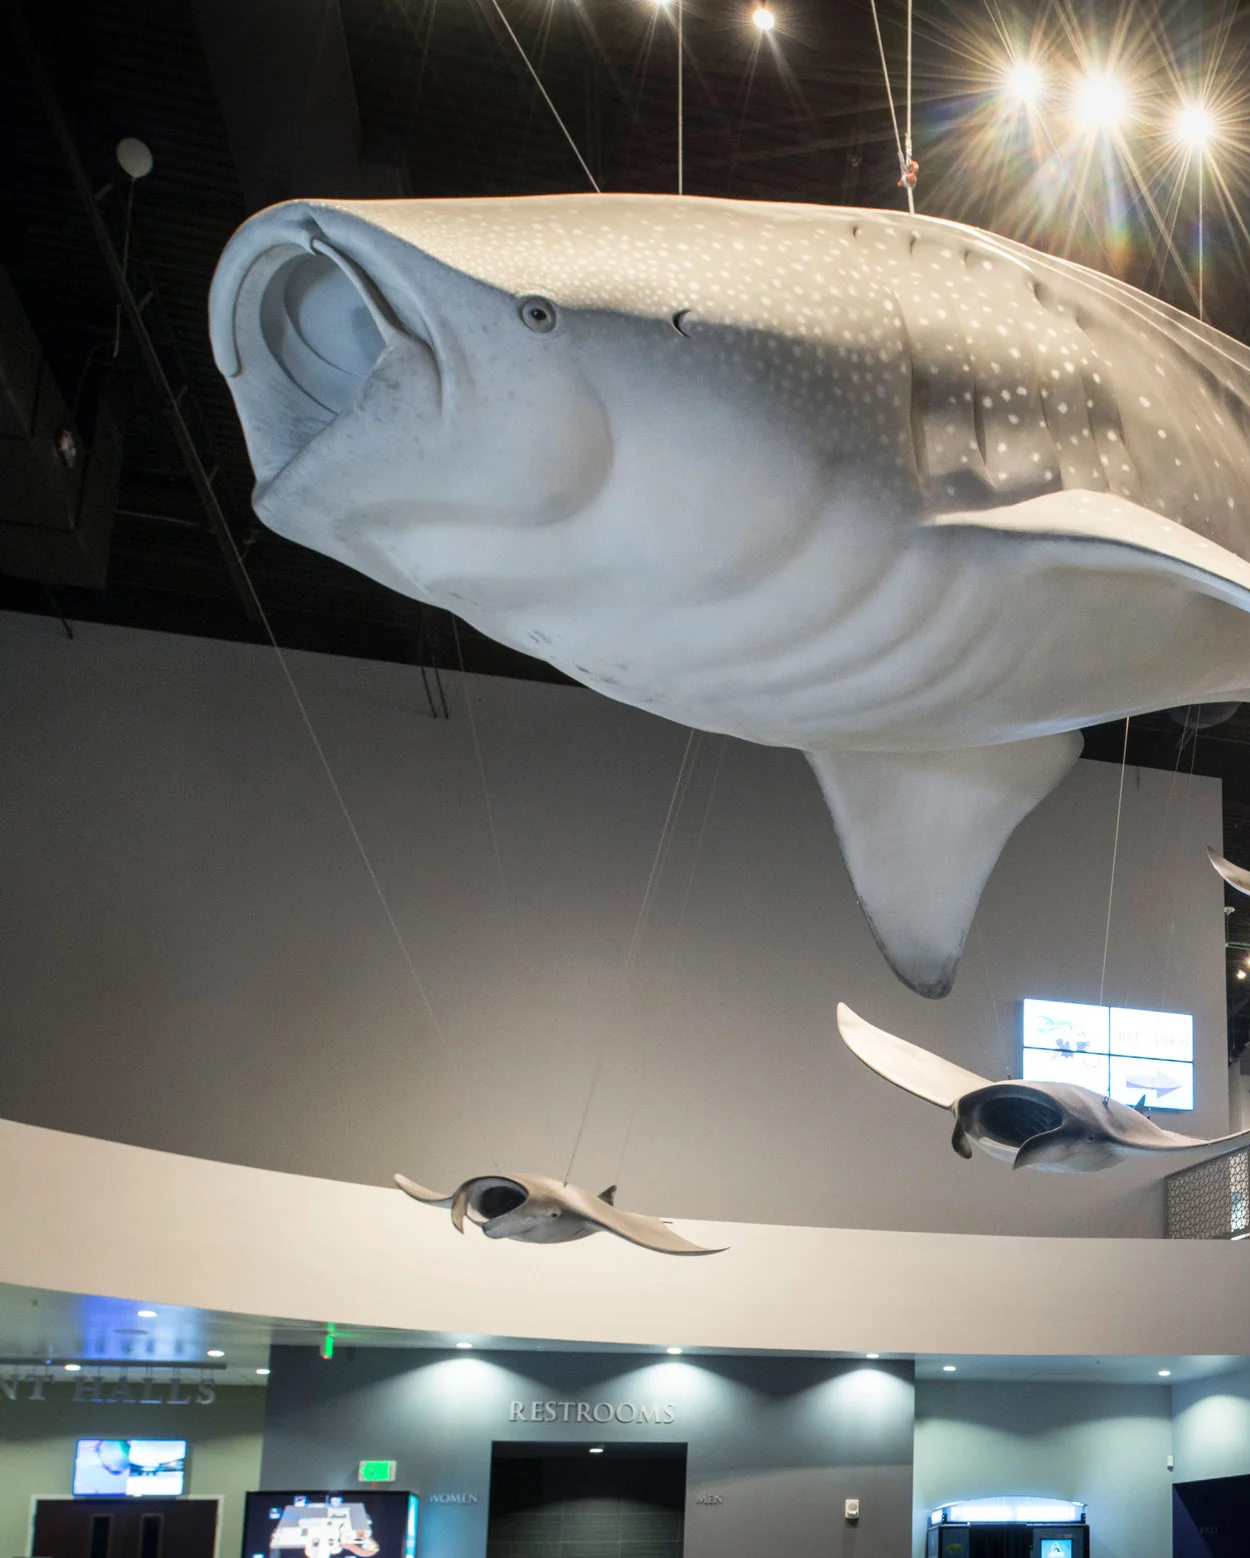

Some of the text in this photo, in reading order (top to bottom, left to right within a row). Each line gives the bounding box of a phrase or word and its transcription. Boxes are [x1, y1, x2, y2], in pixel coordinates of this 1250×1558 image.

[72, 1375, 216, 1405] HALLS
[508, 1400, 676, 1424] RESTROOMS
[428, 1492, 479, 1504] WOMEN
[696, 1494, 724, 1506] MEN
